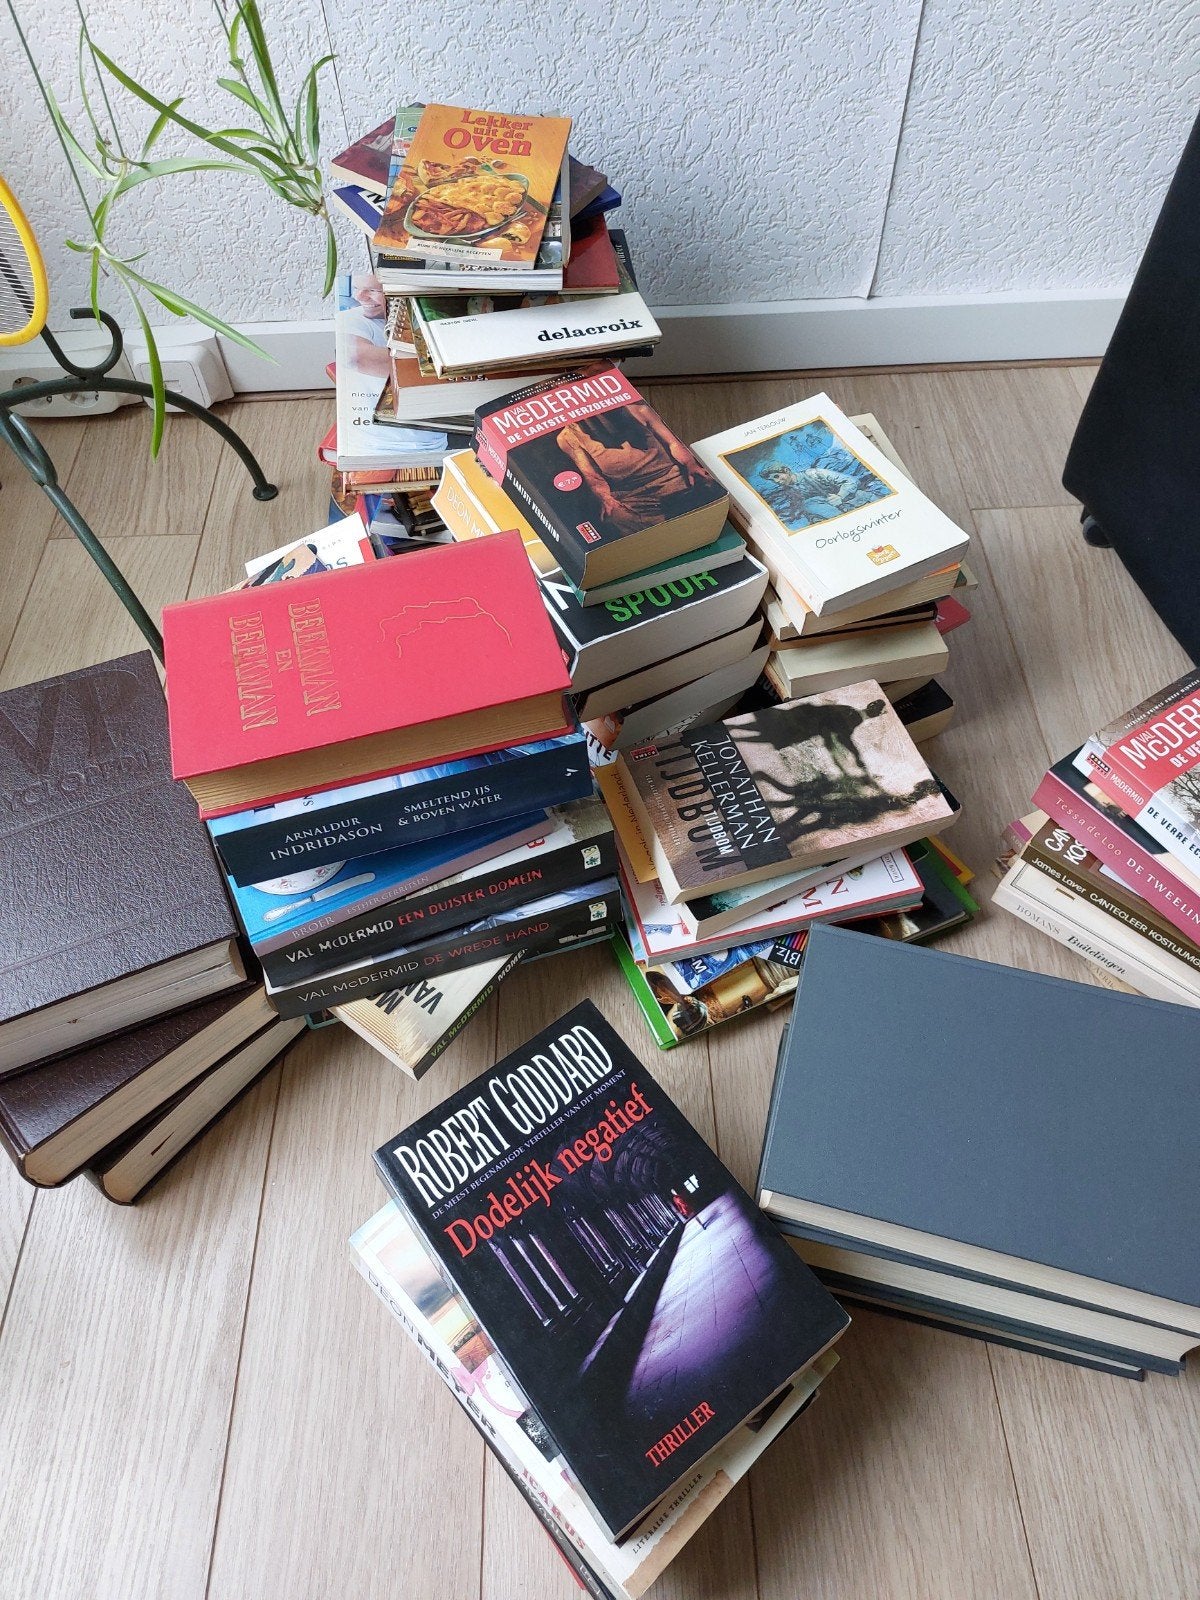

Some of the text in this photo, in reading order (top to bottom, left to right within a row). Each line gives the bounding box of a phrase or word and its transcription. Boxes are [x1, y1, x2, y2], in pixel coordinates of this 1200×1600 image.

[443, 127, 532, 156] Oven
[461, 110, 533, 130] Lekker
[473, 126, 524, 139] uit de
[537, 318, 643, 342] delacroix
[507, 432, 521, 444] DE
[523, 415, 567, 437] LAATSTE
[569, 392, 632, 419] VERZOEKING
[510, 405, 527, 416] VAL
[815, 509, 902, 548] Oorlogswinter
[228, 610, 280, 732] BEEKMAN
[275, 648, 294, 673] EN
[287, 598, 342, 716] BEEKMAN
[1136, 731, 1156, 743] VAL
[1170, 753, 1189, 768] DE
[398, 793, 502, 827] & BOVEN WATER
[403, 785, 491, 814] SMELTEND IJS
[691, 740, 758, 849] KELLERMAN
[714, 735, 781, 843] JONATHAN
[269, 823, 383, 861] INDRIDASON
[284, 817, 362, 843] ARNALDUR
[704, 811, 744, 855] TIJDBOM
[1056, 797, 1086, 827] Tessa
[1087, 826, 1101, 838] de
[1101, 837, 1122, 856] Loo
[1126, 857, 1146, 875] DE
[1147, 806, 1161, 819] DE
[1161, 818, 1189, 844] VERRE
[285, 868, 543, 963] VAL McDERMID EEN DUISTER DOMEIN
[291, 875, 429, 940] BROER ESTHER GERRITSEN
[1031, 857, 1061, 879] James
[1061, 874, 1087, 894] Laver
[1089, 892, 1148, 933] CANTECLEER
[297, 988, 331, 1003] VAL
[332, 961, 420, 993] McDERMID
[424, 953, 445, 966] DE
[448, 938, 502, 959] WREDE
[505, 921, 551, 940] HAND
[1016, 903, 1127, 976] BOMANS Buitelingen
[431, 1039, 448, 1057] VAL
[448, 984, 494, 1038] McDERMID
[393, 1025, 613, 1207] ROBERT GODDARD
[432, 1068, 627, 1220] DE MEEST BEGENADIGDE VERTELLER VAN DIT MOMENT
[443, 1081, 653, 1258] Dodelijk negatief
[368, 1270, 498, 1439] DEON MEYER
[645, 1401, 716, 1468] THRILLER
[521, 1467, 586, 1550] ICARUS
[632, 1473, 704, 1554] LITERAIRE THRILLER
